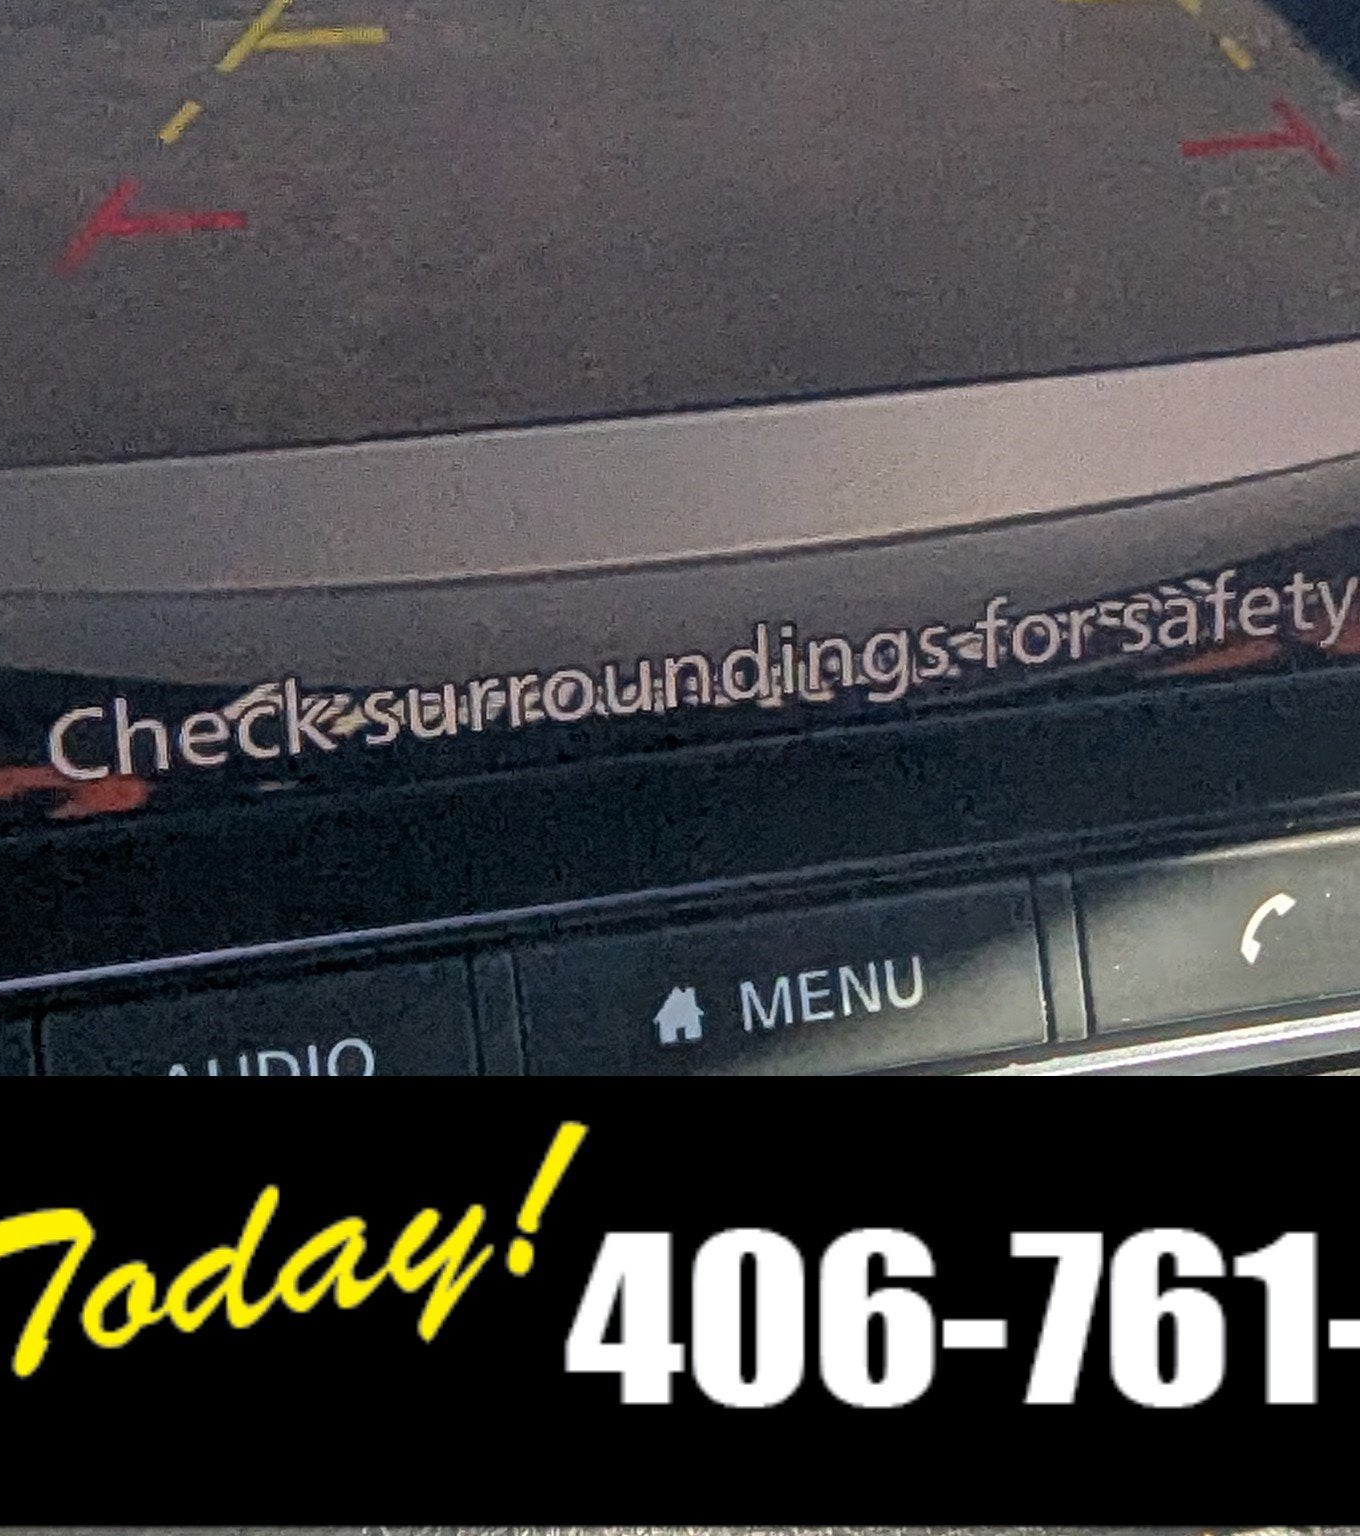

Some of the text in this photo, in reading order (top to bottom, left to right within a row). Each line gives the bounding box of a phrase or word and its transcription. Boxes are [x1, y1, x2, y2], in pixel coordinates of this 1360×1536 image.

[48, 677, 338, 781] Check
[364, 621, 950, 747] surroundings
[976, 595, 1100, 670] for
[739, 955, 925, 1035] MENU
